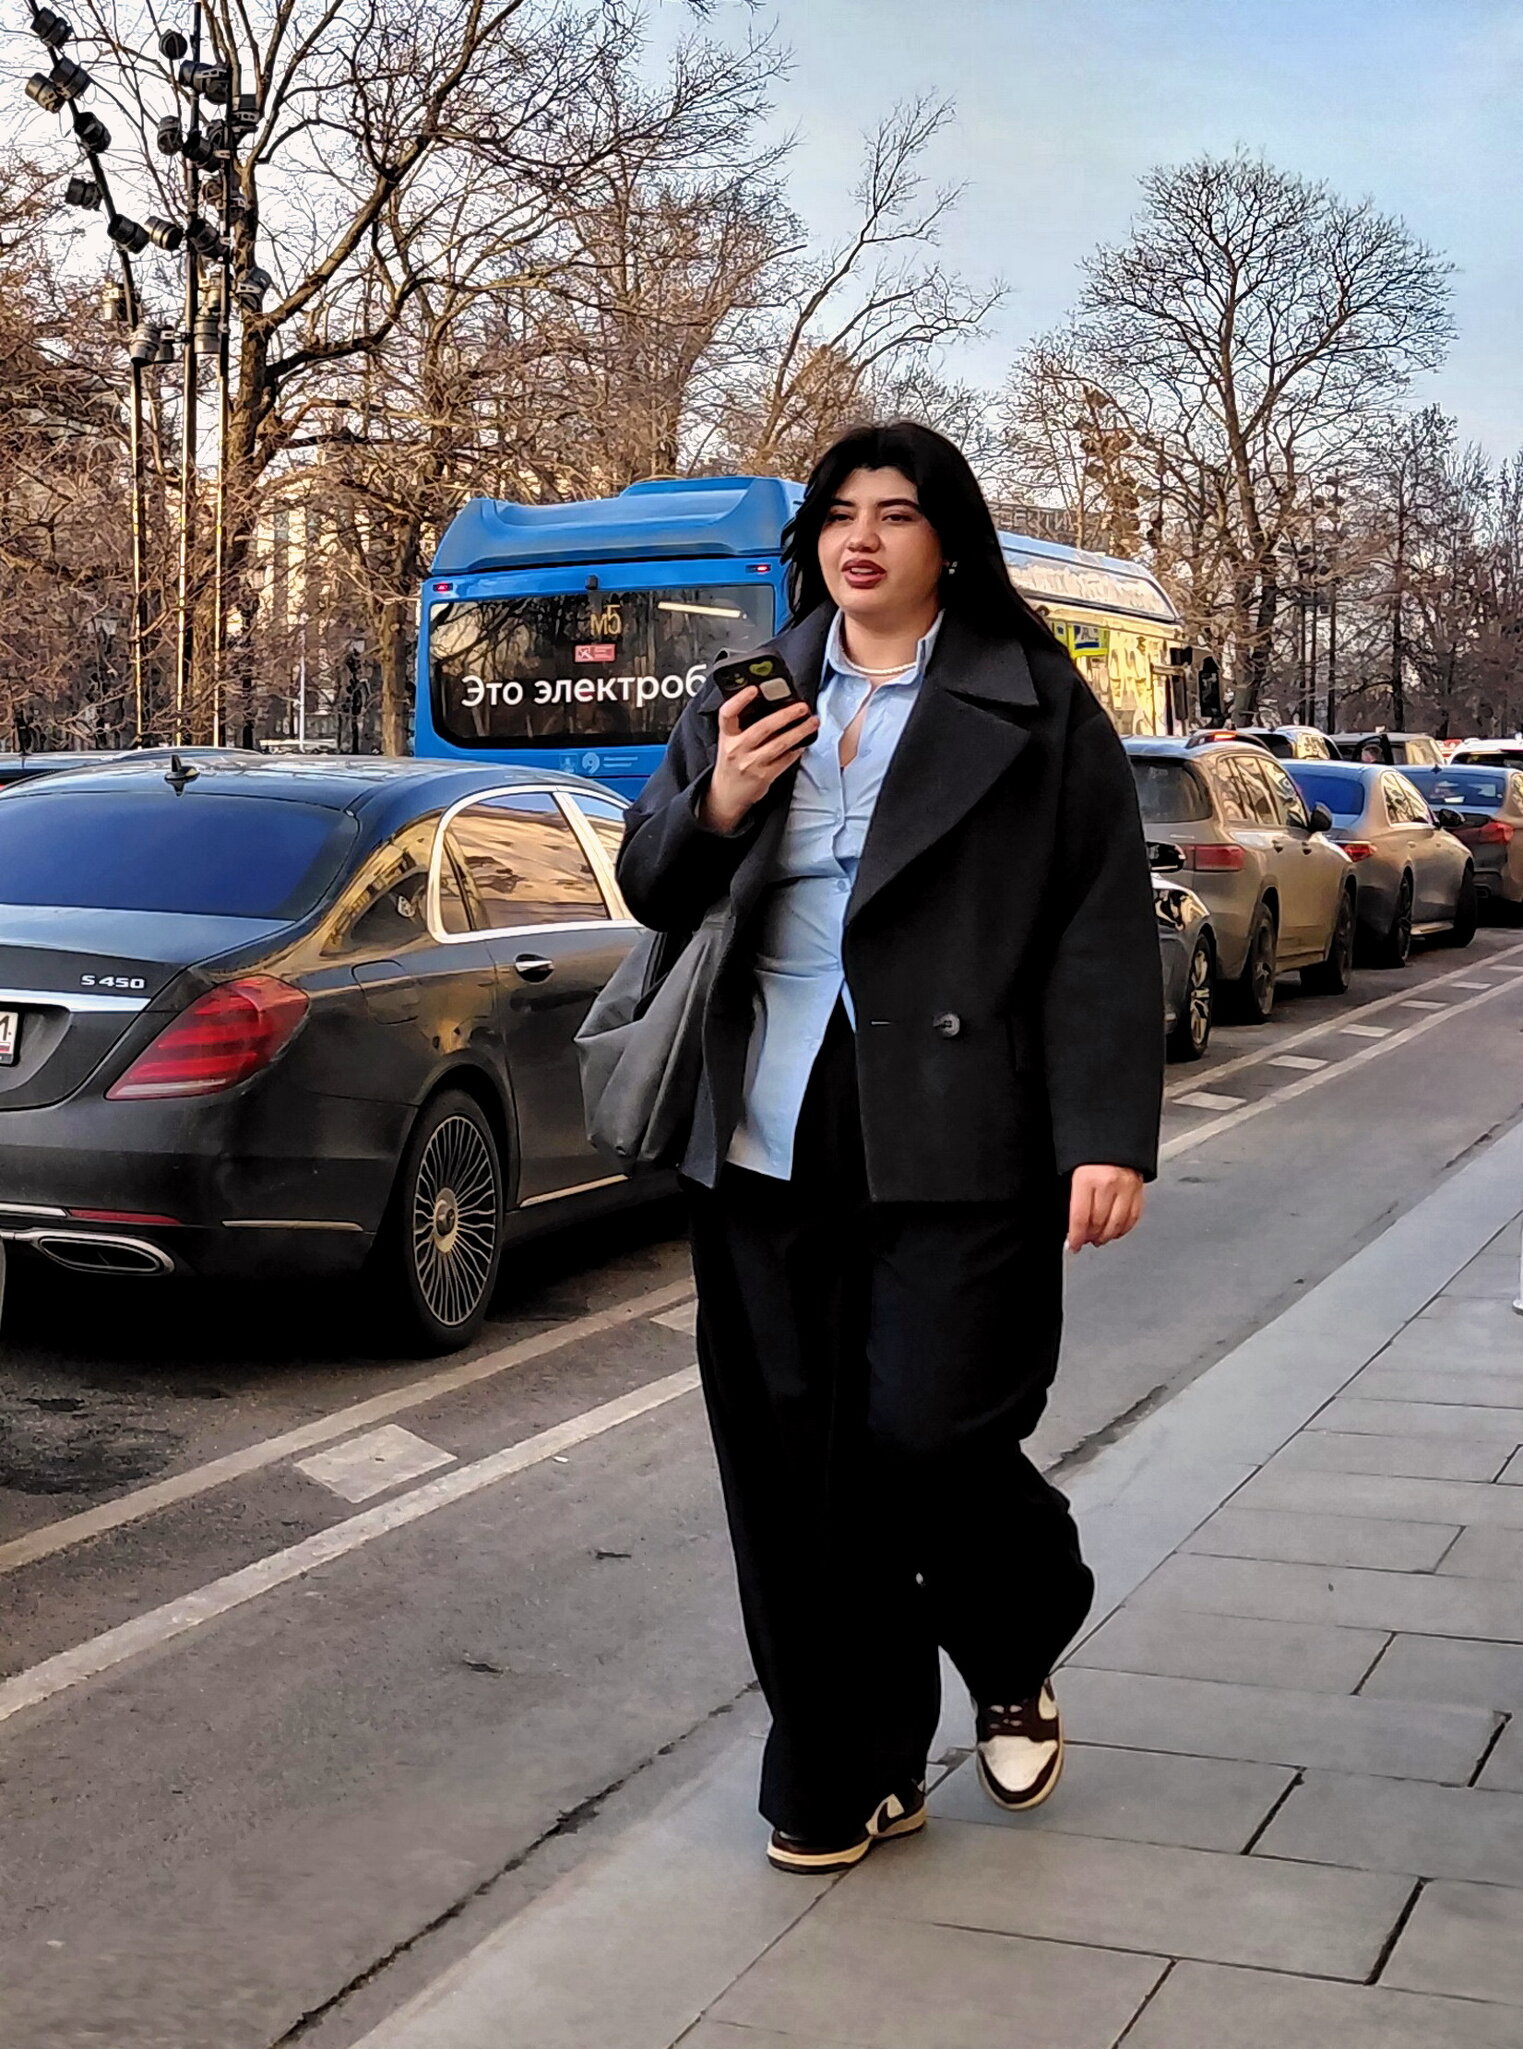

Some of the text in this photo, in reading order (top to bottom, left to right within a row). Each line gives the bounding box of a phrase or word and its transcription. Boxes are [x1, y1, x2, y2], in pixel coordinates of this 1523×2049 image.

[461, 674, 524, 707] Это
[80, 974, 145, 989] S 450
